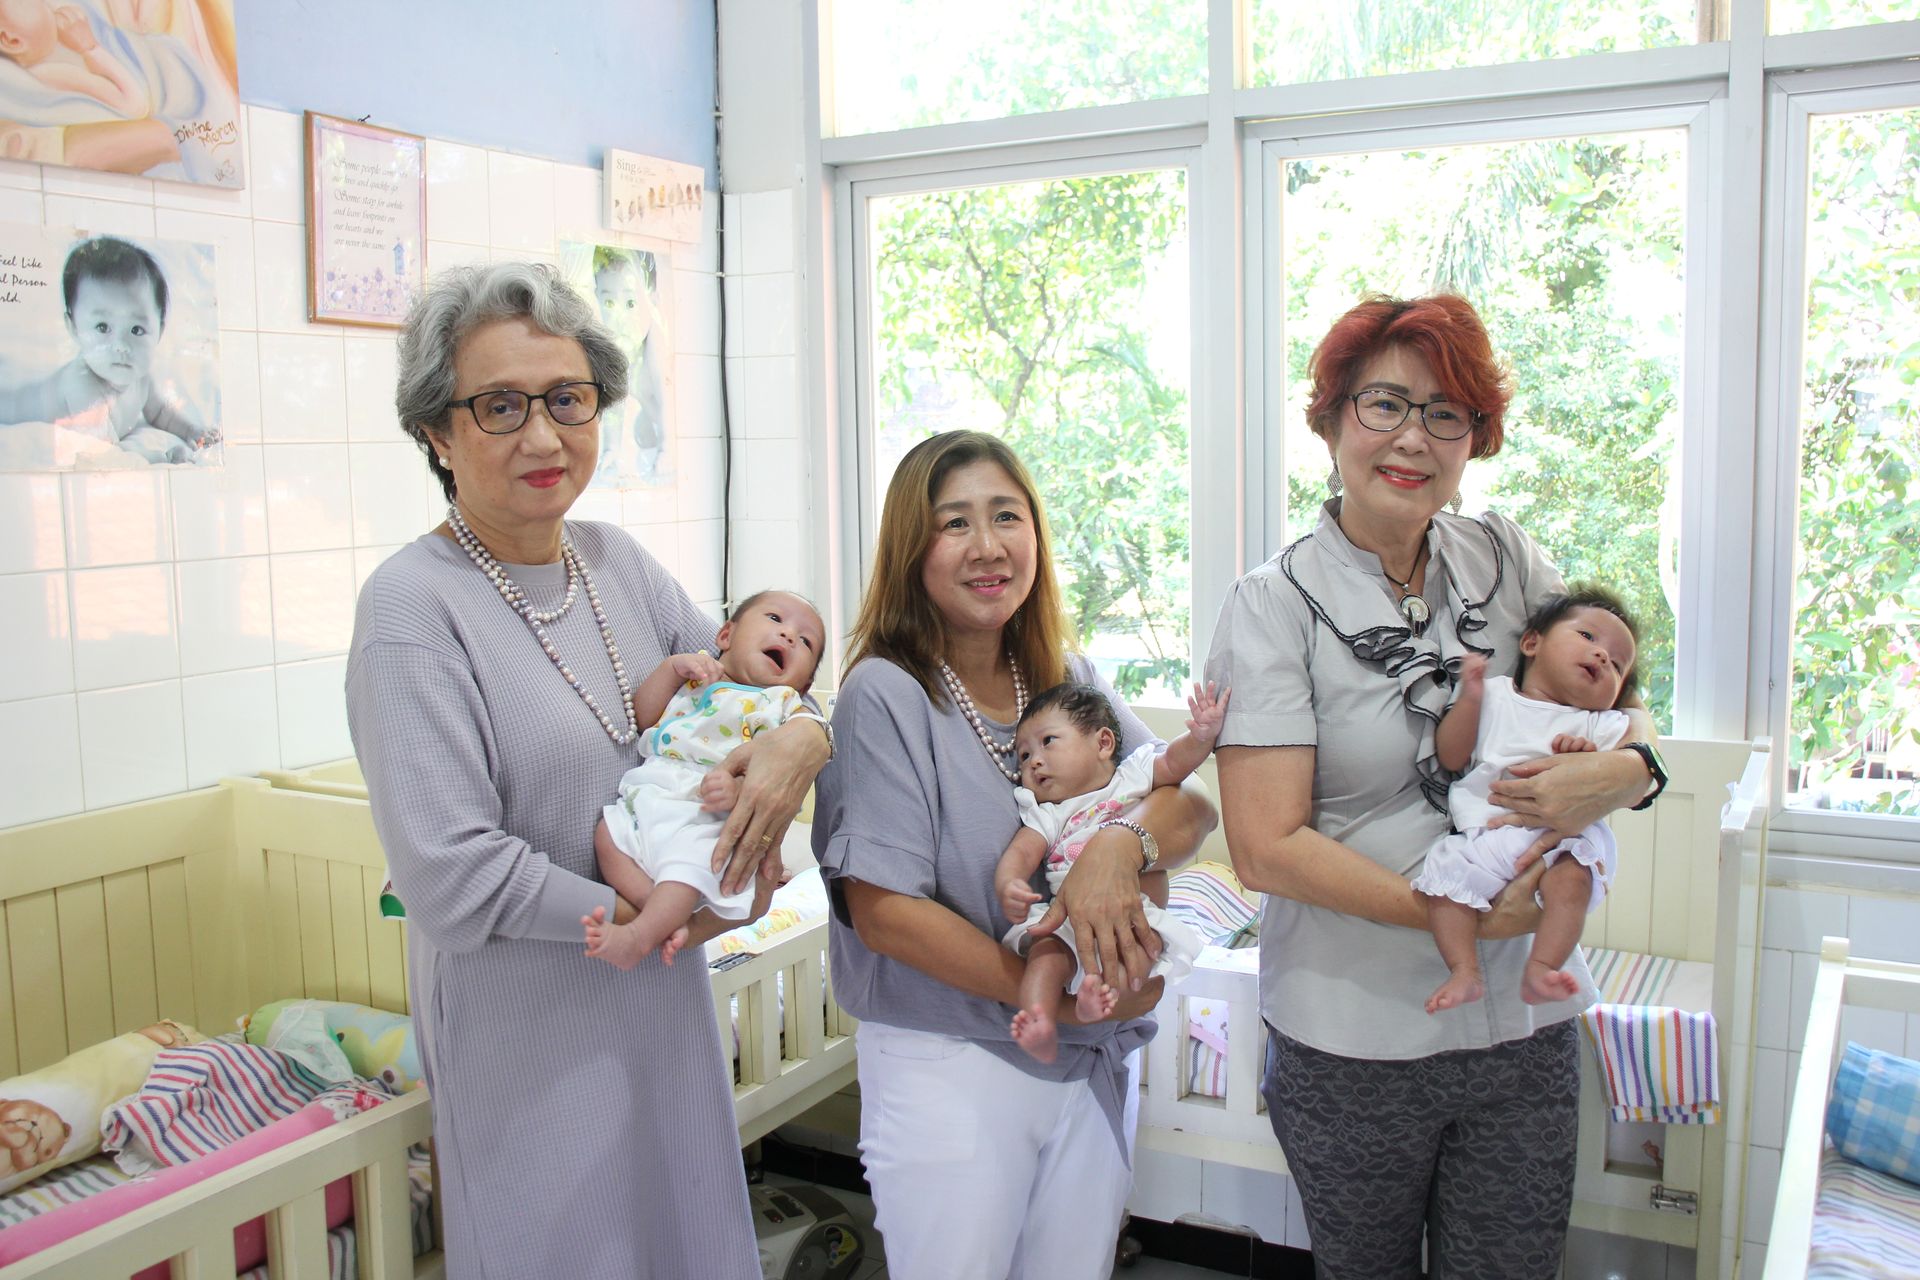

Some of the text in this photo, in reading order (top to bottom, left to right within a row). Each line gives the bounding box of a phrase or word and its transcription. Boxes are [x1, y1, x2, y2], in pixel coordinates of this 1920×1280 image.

[174, 121, 213, 144] Divine
[198, 120, 238, 147] Mercy
[332, 156, 360, 171] Some
[360, 163, 382, 177] people
[616, 158, 637, 176] Sing
[357, 177, 370, 187] and
[333, 188, 361, 204] Some
[360, 196, 377, 210] stay
[333, 207, 345, 216] and
[345, 222, 362, 232] hearts
[363, 225, 376, 235] and
[361, 239, 371, 248] the
[21, 257, 43, 269] Like
[12, 274, 48, 288] Person
